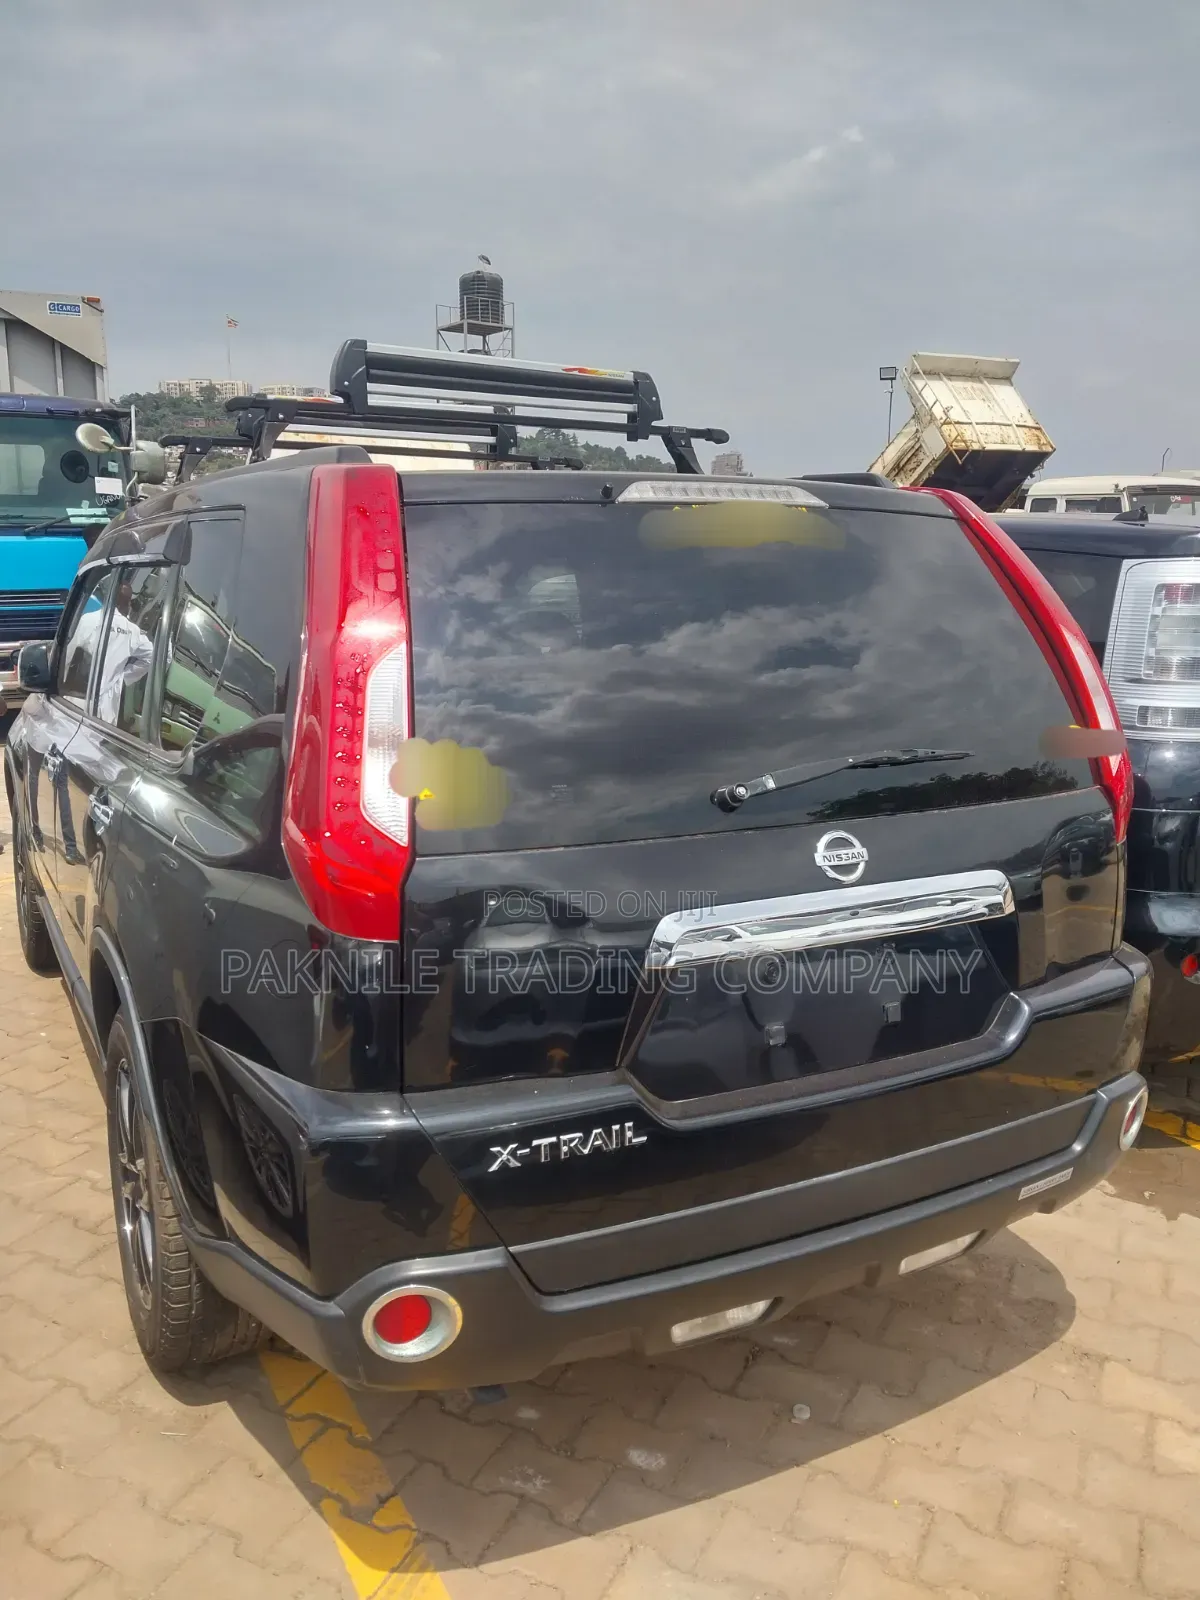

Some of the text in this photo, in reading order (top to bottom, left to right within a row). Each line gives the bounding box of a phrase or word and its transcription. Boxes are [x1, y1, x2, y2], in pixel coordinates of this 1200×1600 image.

[58, 304, 80, 312] CARGO
[822, 851, 865, 863] NISSAN
[487, 1121, 648, 1172] X-TRAIL
